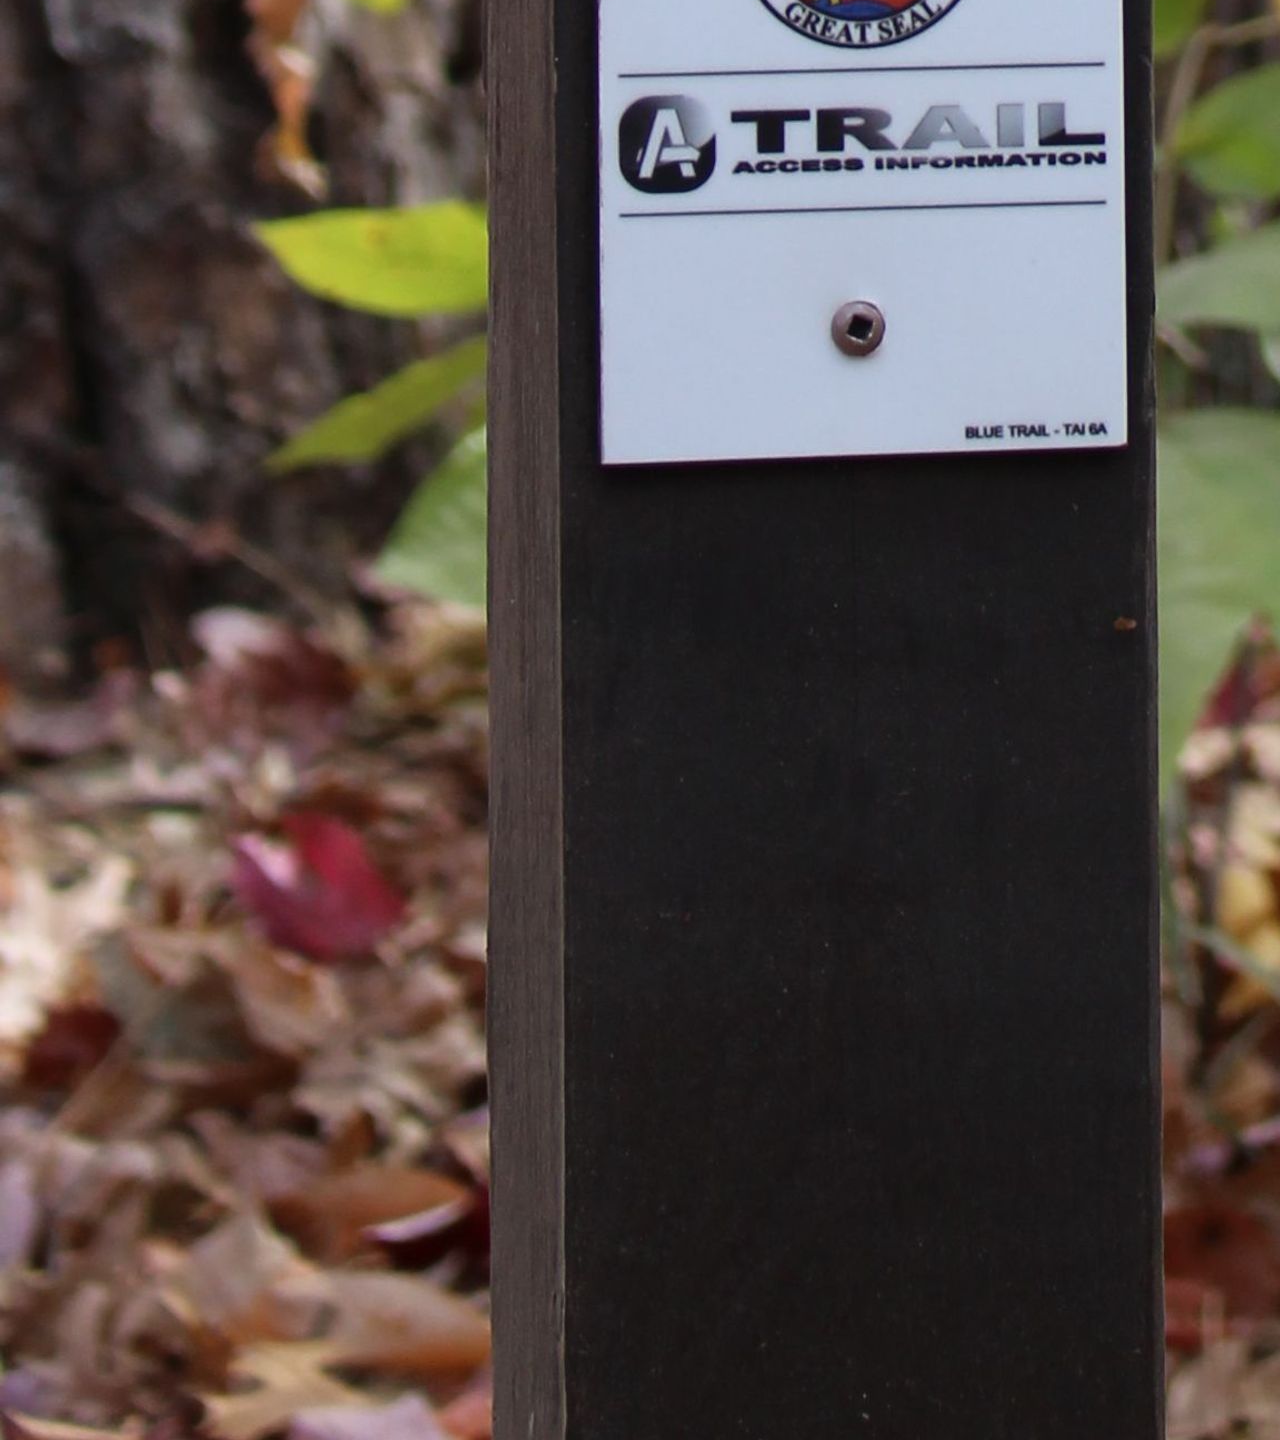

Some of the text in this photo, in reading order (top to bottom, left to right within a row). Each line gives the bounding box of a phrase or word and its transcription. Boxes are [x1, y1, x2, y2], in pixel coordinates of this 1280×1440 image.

[784, 0, 944, 45] GREAT SEAL
[730, 103, 1106, 155] TRAIL
[731, 151, 1107, 175] ACCESS INFORMATION
[964, 424, 1004, 440] BLUE
[1007, 424, 1051, 438] TRAIL
[1063, 423, 1086, 437] TAI
[1088, 422, 1108, 437] 6A
